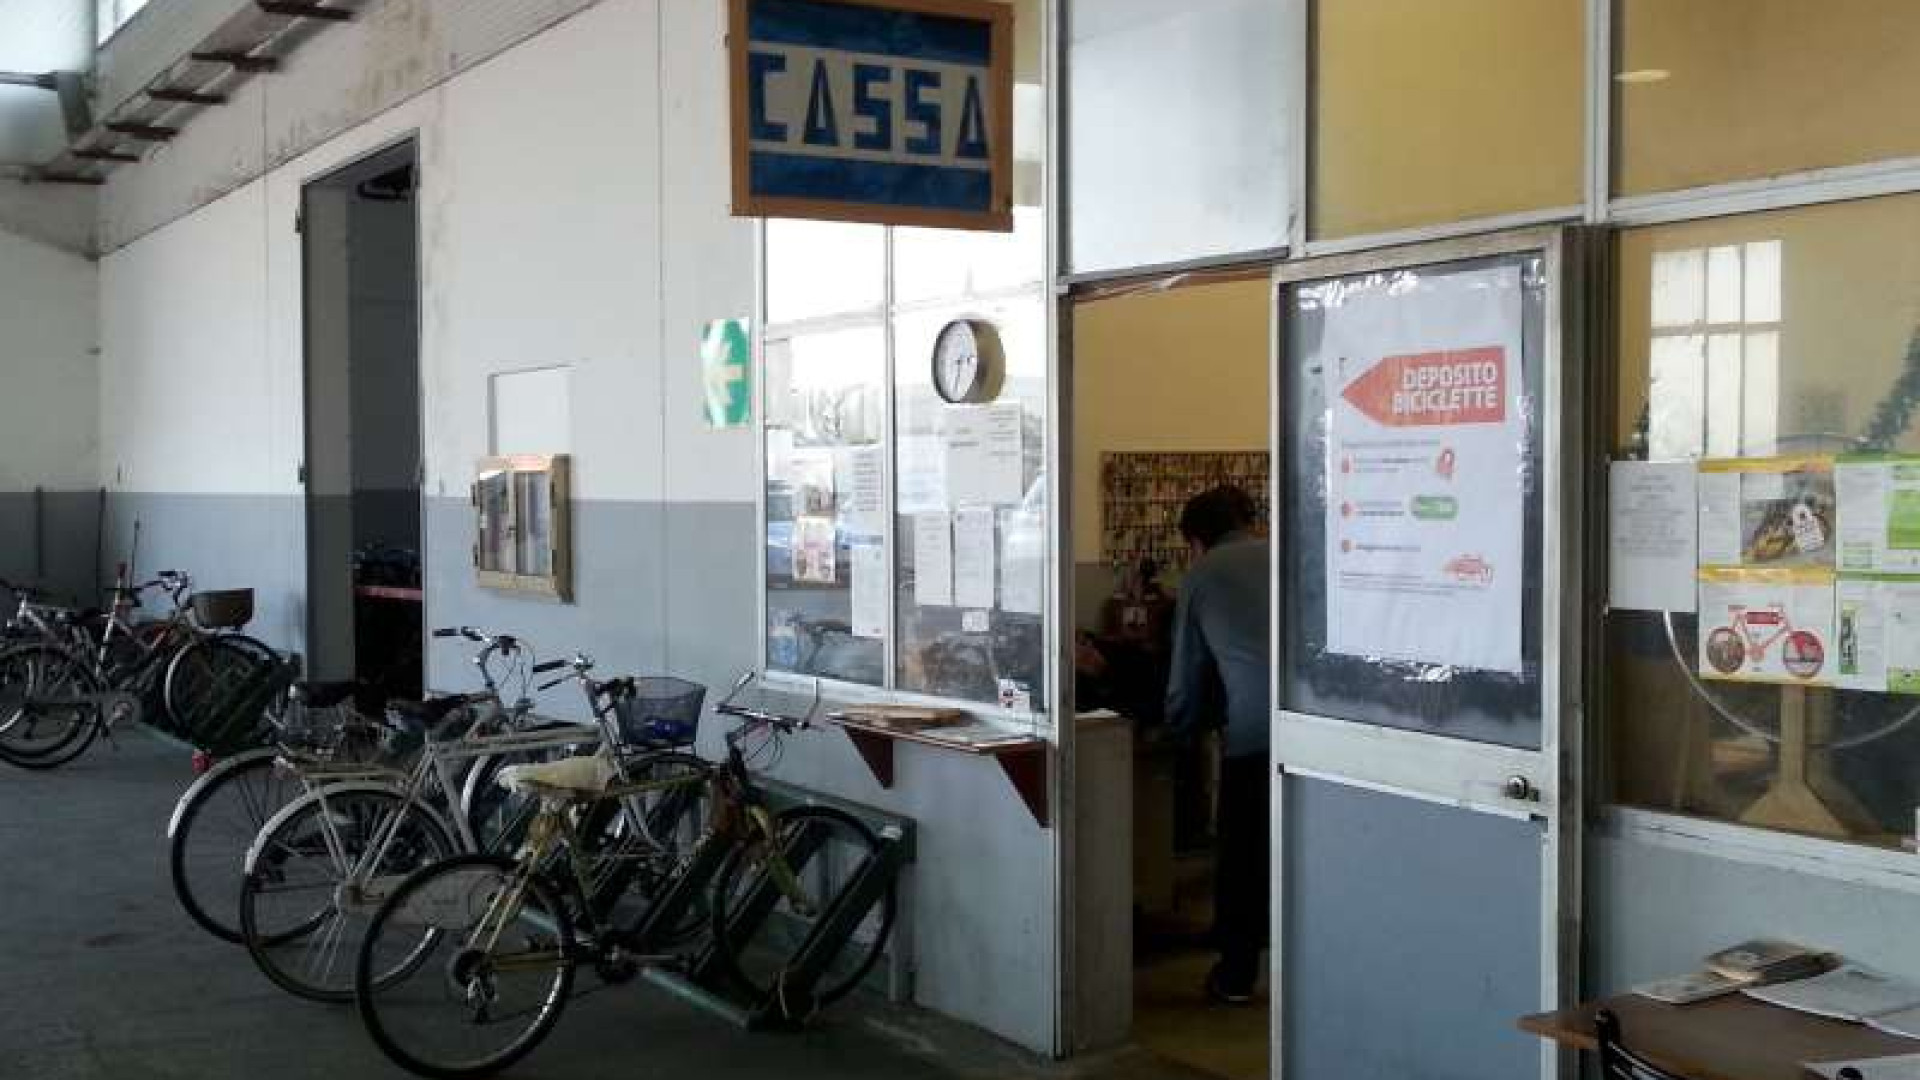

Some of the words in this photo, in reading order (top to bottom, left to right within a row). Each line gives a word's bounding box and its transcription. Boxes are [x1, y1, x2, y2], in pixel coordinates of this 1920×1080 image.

[749, 53, 989, 159] CASSA
[1403, 361, 1497, 390] DEPOSITO
[1392, 386, 1498, 416] BICICLETTE
